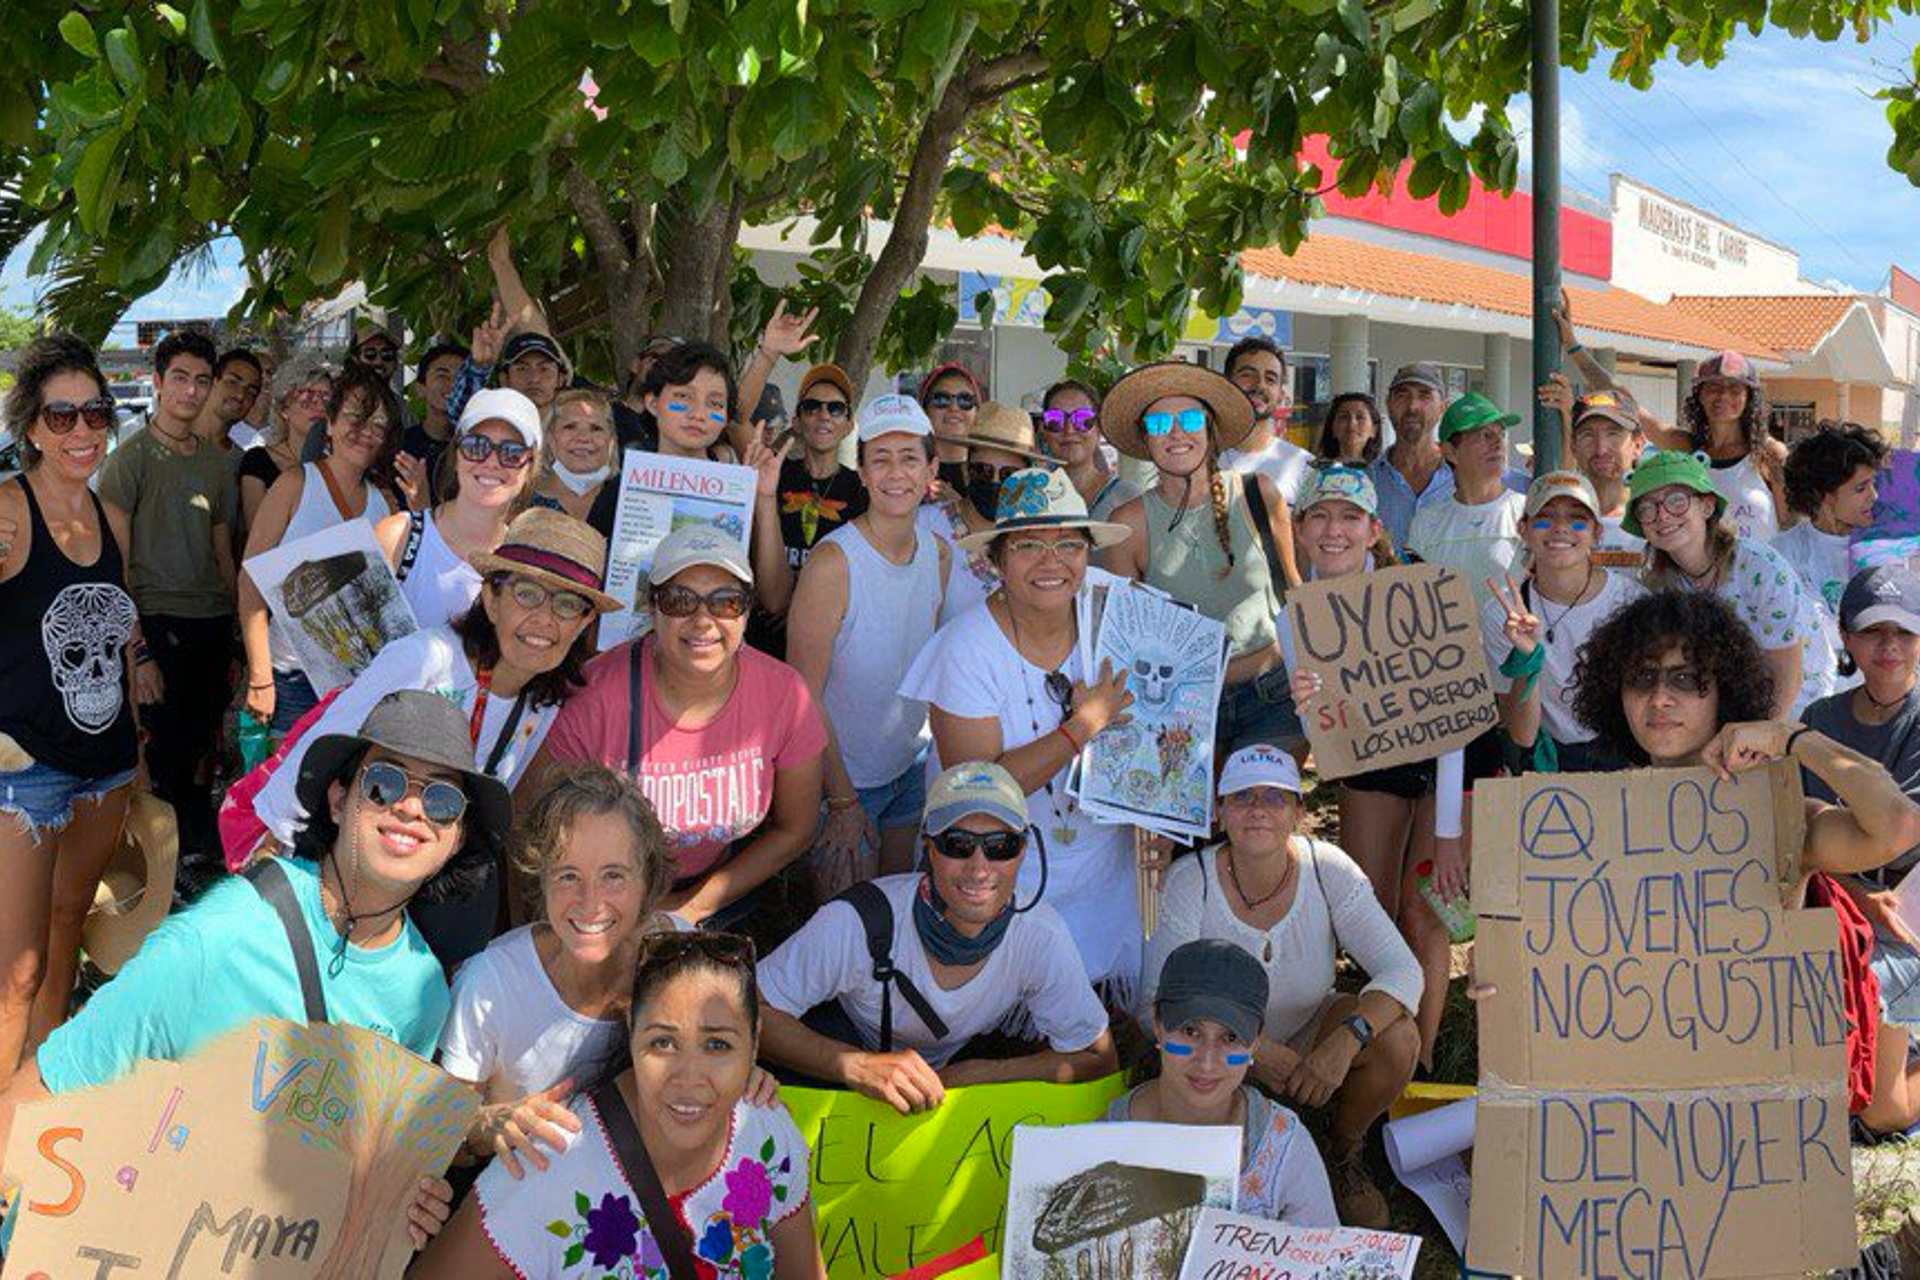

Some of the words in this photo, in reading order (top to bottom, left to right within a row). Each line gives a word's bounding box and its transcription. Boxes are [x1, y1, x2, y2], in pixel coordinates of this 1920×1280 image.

[629, 465, 723, 497] MILENIO
[1296, 584, 1372, 662] UY
[1386, 568, 1469, 648] QUÉ
[1352, 732, 1394, 761] LOS
[1397, 701, 1500, 749] HOTELEROS
[1362, 693, 1403, 728] LE
[1409, 673, 1489, 712] DIERON
[1621, 775, 1750, 856] LOS
[1525, 859, 1771, 957] JÓVENES
[1531, 957, 1653, 1044] NOS
[1214, 1223, 1292, 1257] TREN
